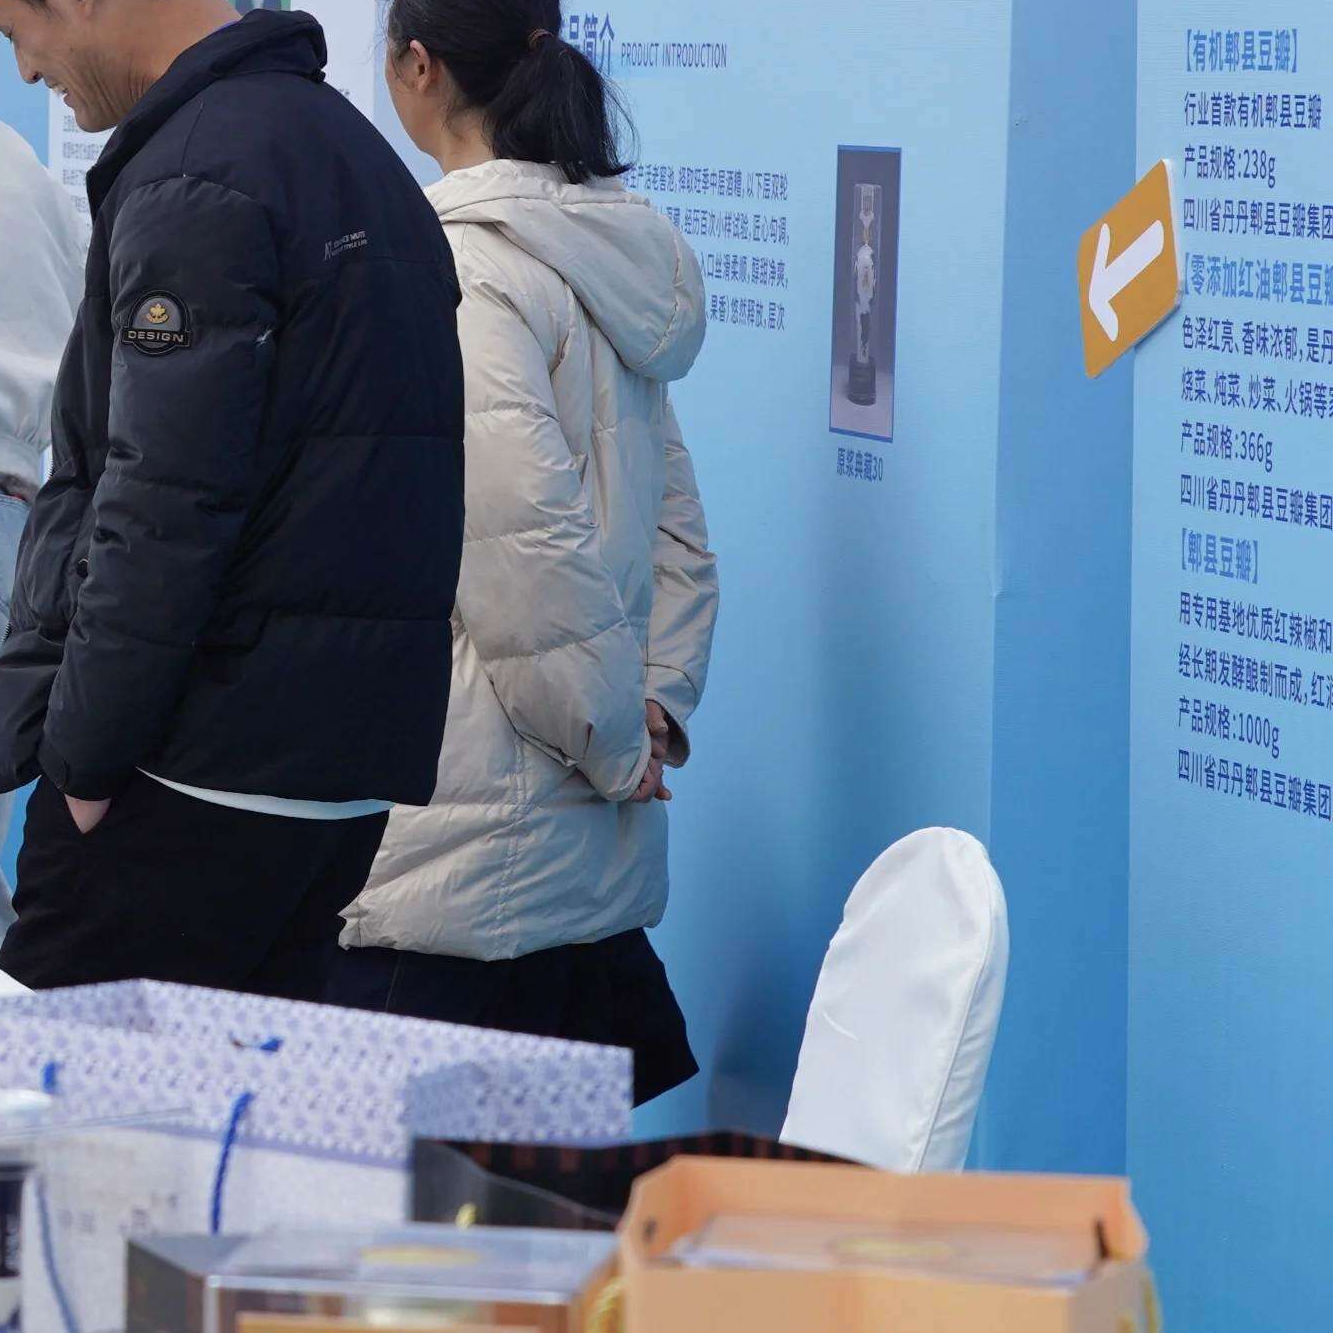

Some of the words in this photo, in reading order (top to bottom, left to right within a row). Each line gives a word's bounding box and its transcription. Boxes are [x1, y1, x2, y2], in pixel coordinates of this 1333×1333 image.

[561, 12, 615, 75] 品简介
[621, 43, 660, 67] PRODUCT
[662, 43, 728, 68] INTRODUCTION
[1185, 28, 1299, 74] 【有机郫县豆瓣】
[1184, 91, 1322, 130] 行业首款有机郫县豆瓣
[1183, 198, 1333, 241] 四川省丹丹郫县豆瓣集团
[128, 329, 184, 343] DESIGN
[837, 447, 884, 483] 原浆典藏30
[1180, 474, 1333, 531] 四川省丹丹郫县豆瓣集团
[1179, 592, 1333, 656] 用专用基地优质红辣椒和
[1177, 749, 1333, 822] 四川省丹丹郫县豆瓣集团
